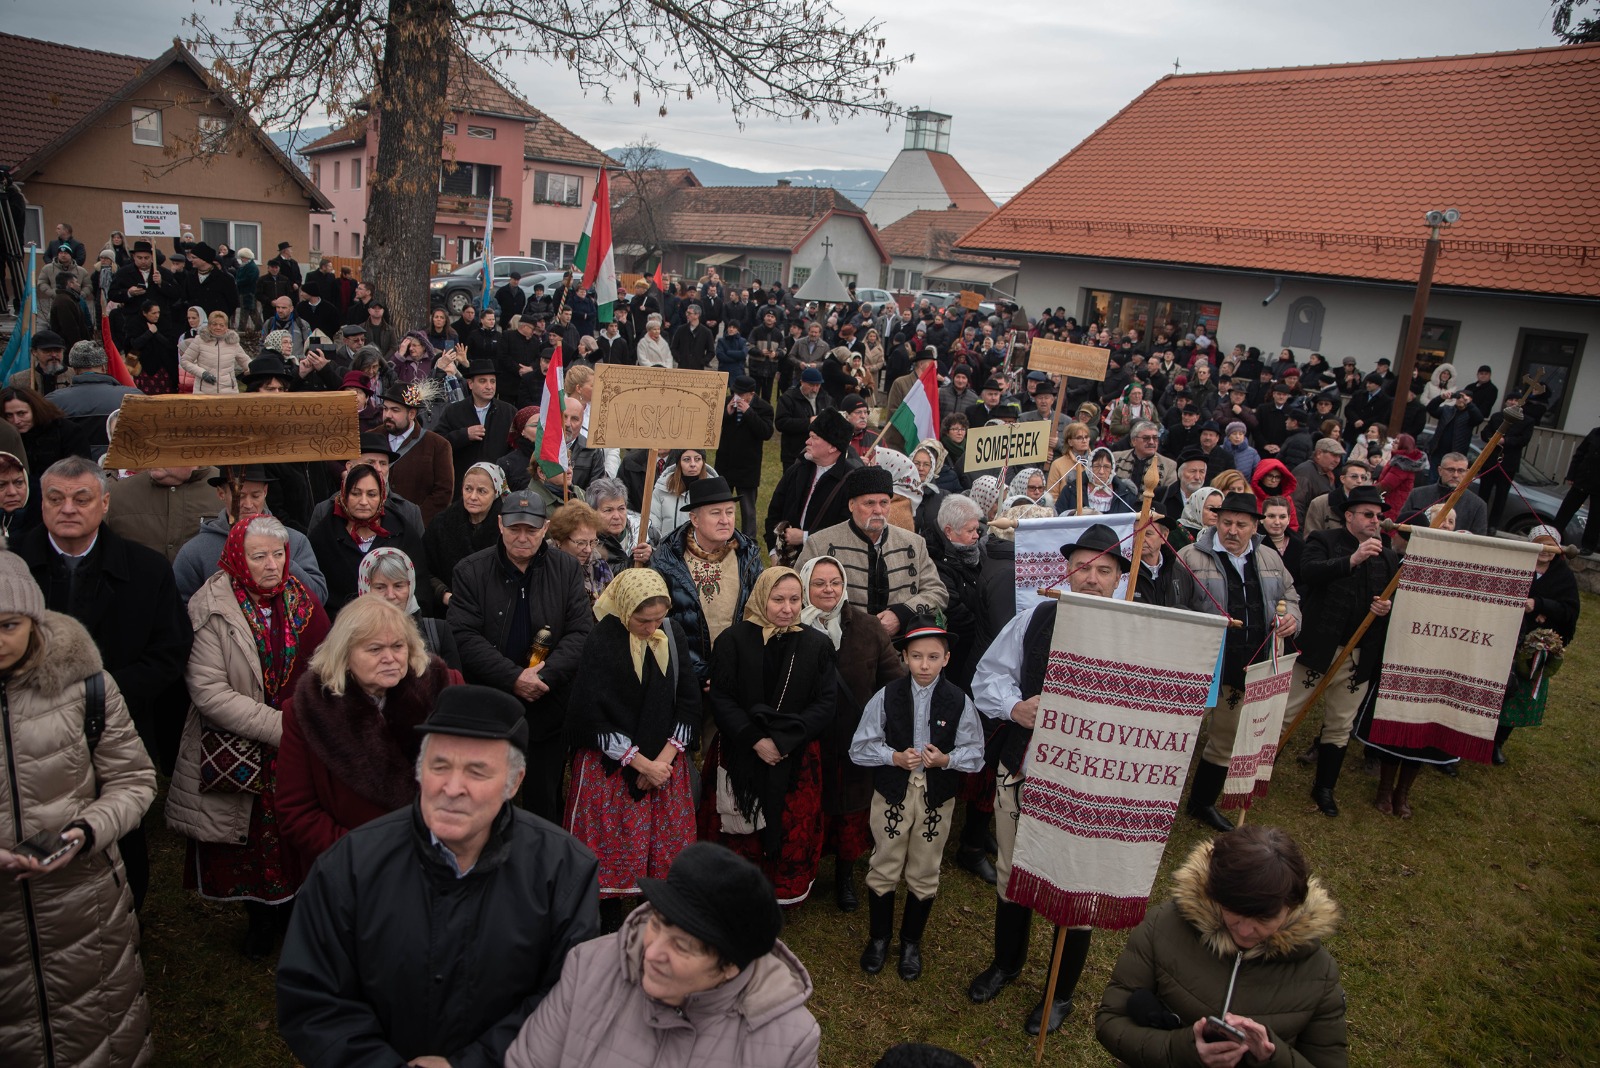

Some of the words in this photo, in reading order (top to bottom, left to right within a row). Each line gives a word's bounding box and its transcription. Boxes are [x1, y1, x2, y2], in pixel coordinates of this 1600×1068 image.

[614, 399, 700, 440] VASKÚT
[975, 431, 1040, 464] SOMBEREK
[1411, 621, 1495, 647] BÁTASZÉK
[1040, 709, 1190, 752] BUKOVINAI
[1035, 743, 1182, 787] SZÉKELYEK
